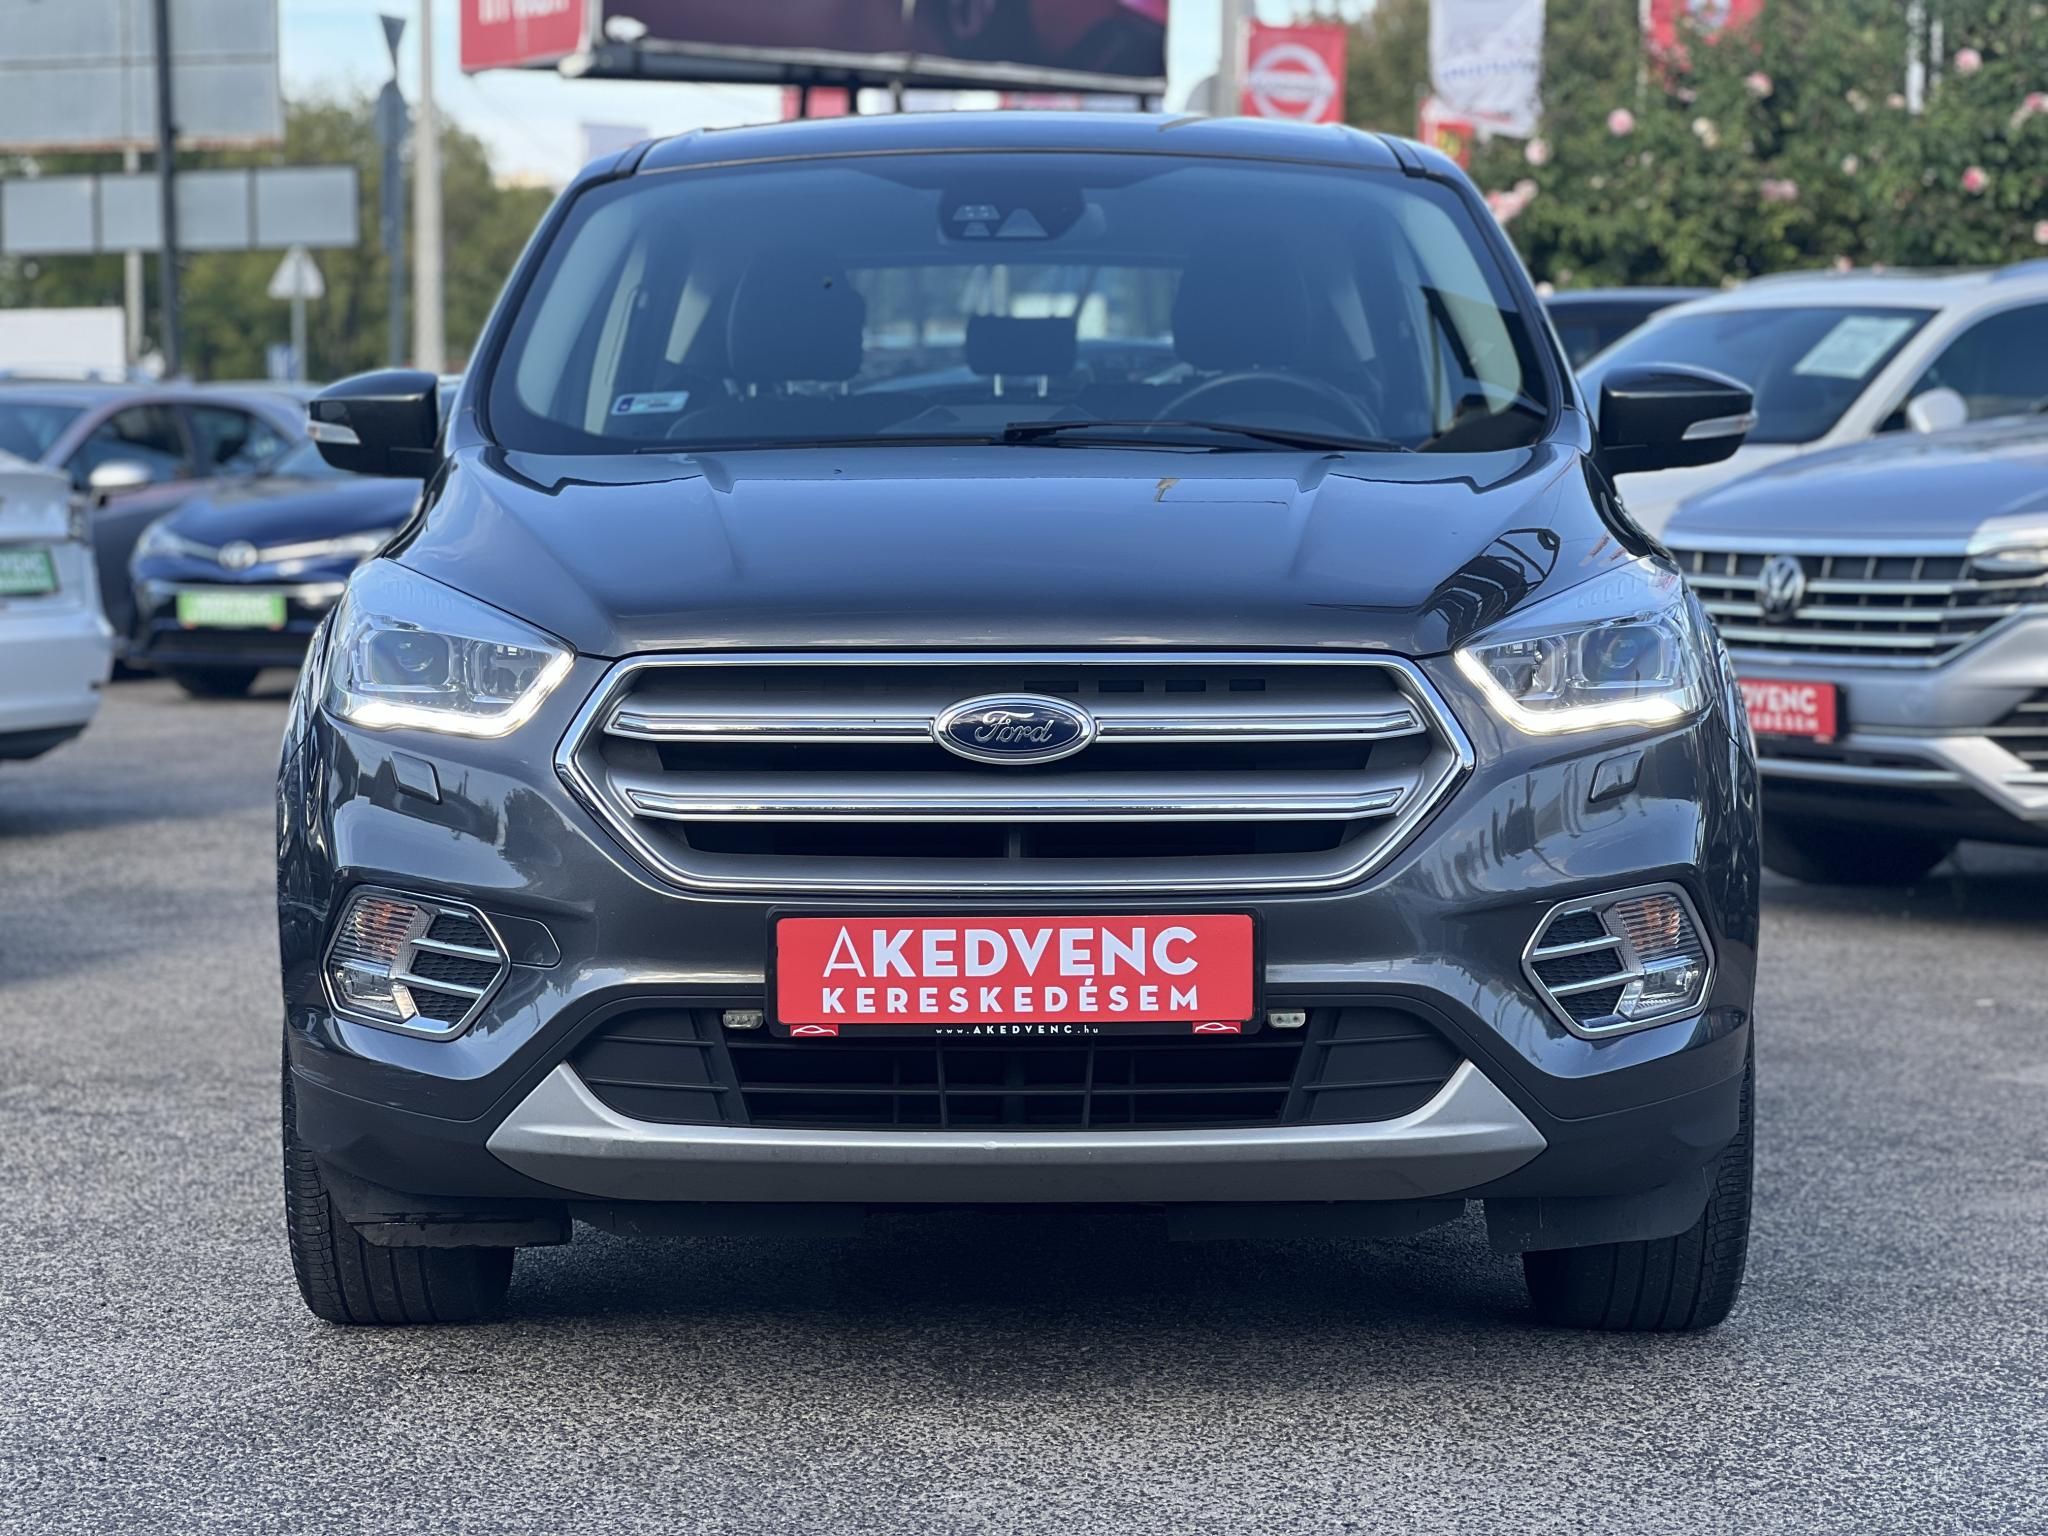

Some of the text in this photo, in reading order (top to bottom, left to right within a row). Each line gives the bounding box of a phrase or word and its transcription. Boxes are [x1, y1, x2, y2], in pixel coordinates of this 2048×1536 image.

[974, 710, 1053, 743] Ford
[822, 925, 1199, 978] AKEDVENC
[822, 978, 1199, 1014] KERESKEDÉSEM
